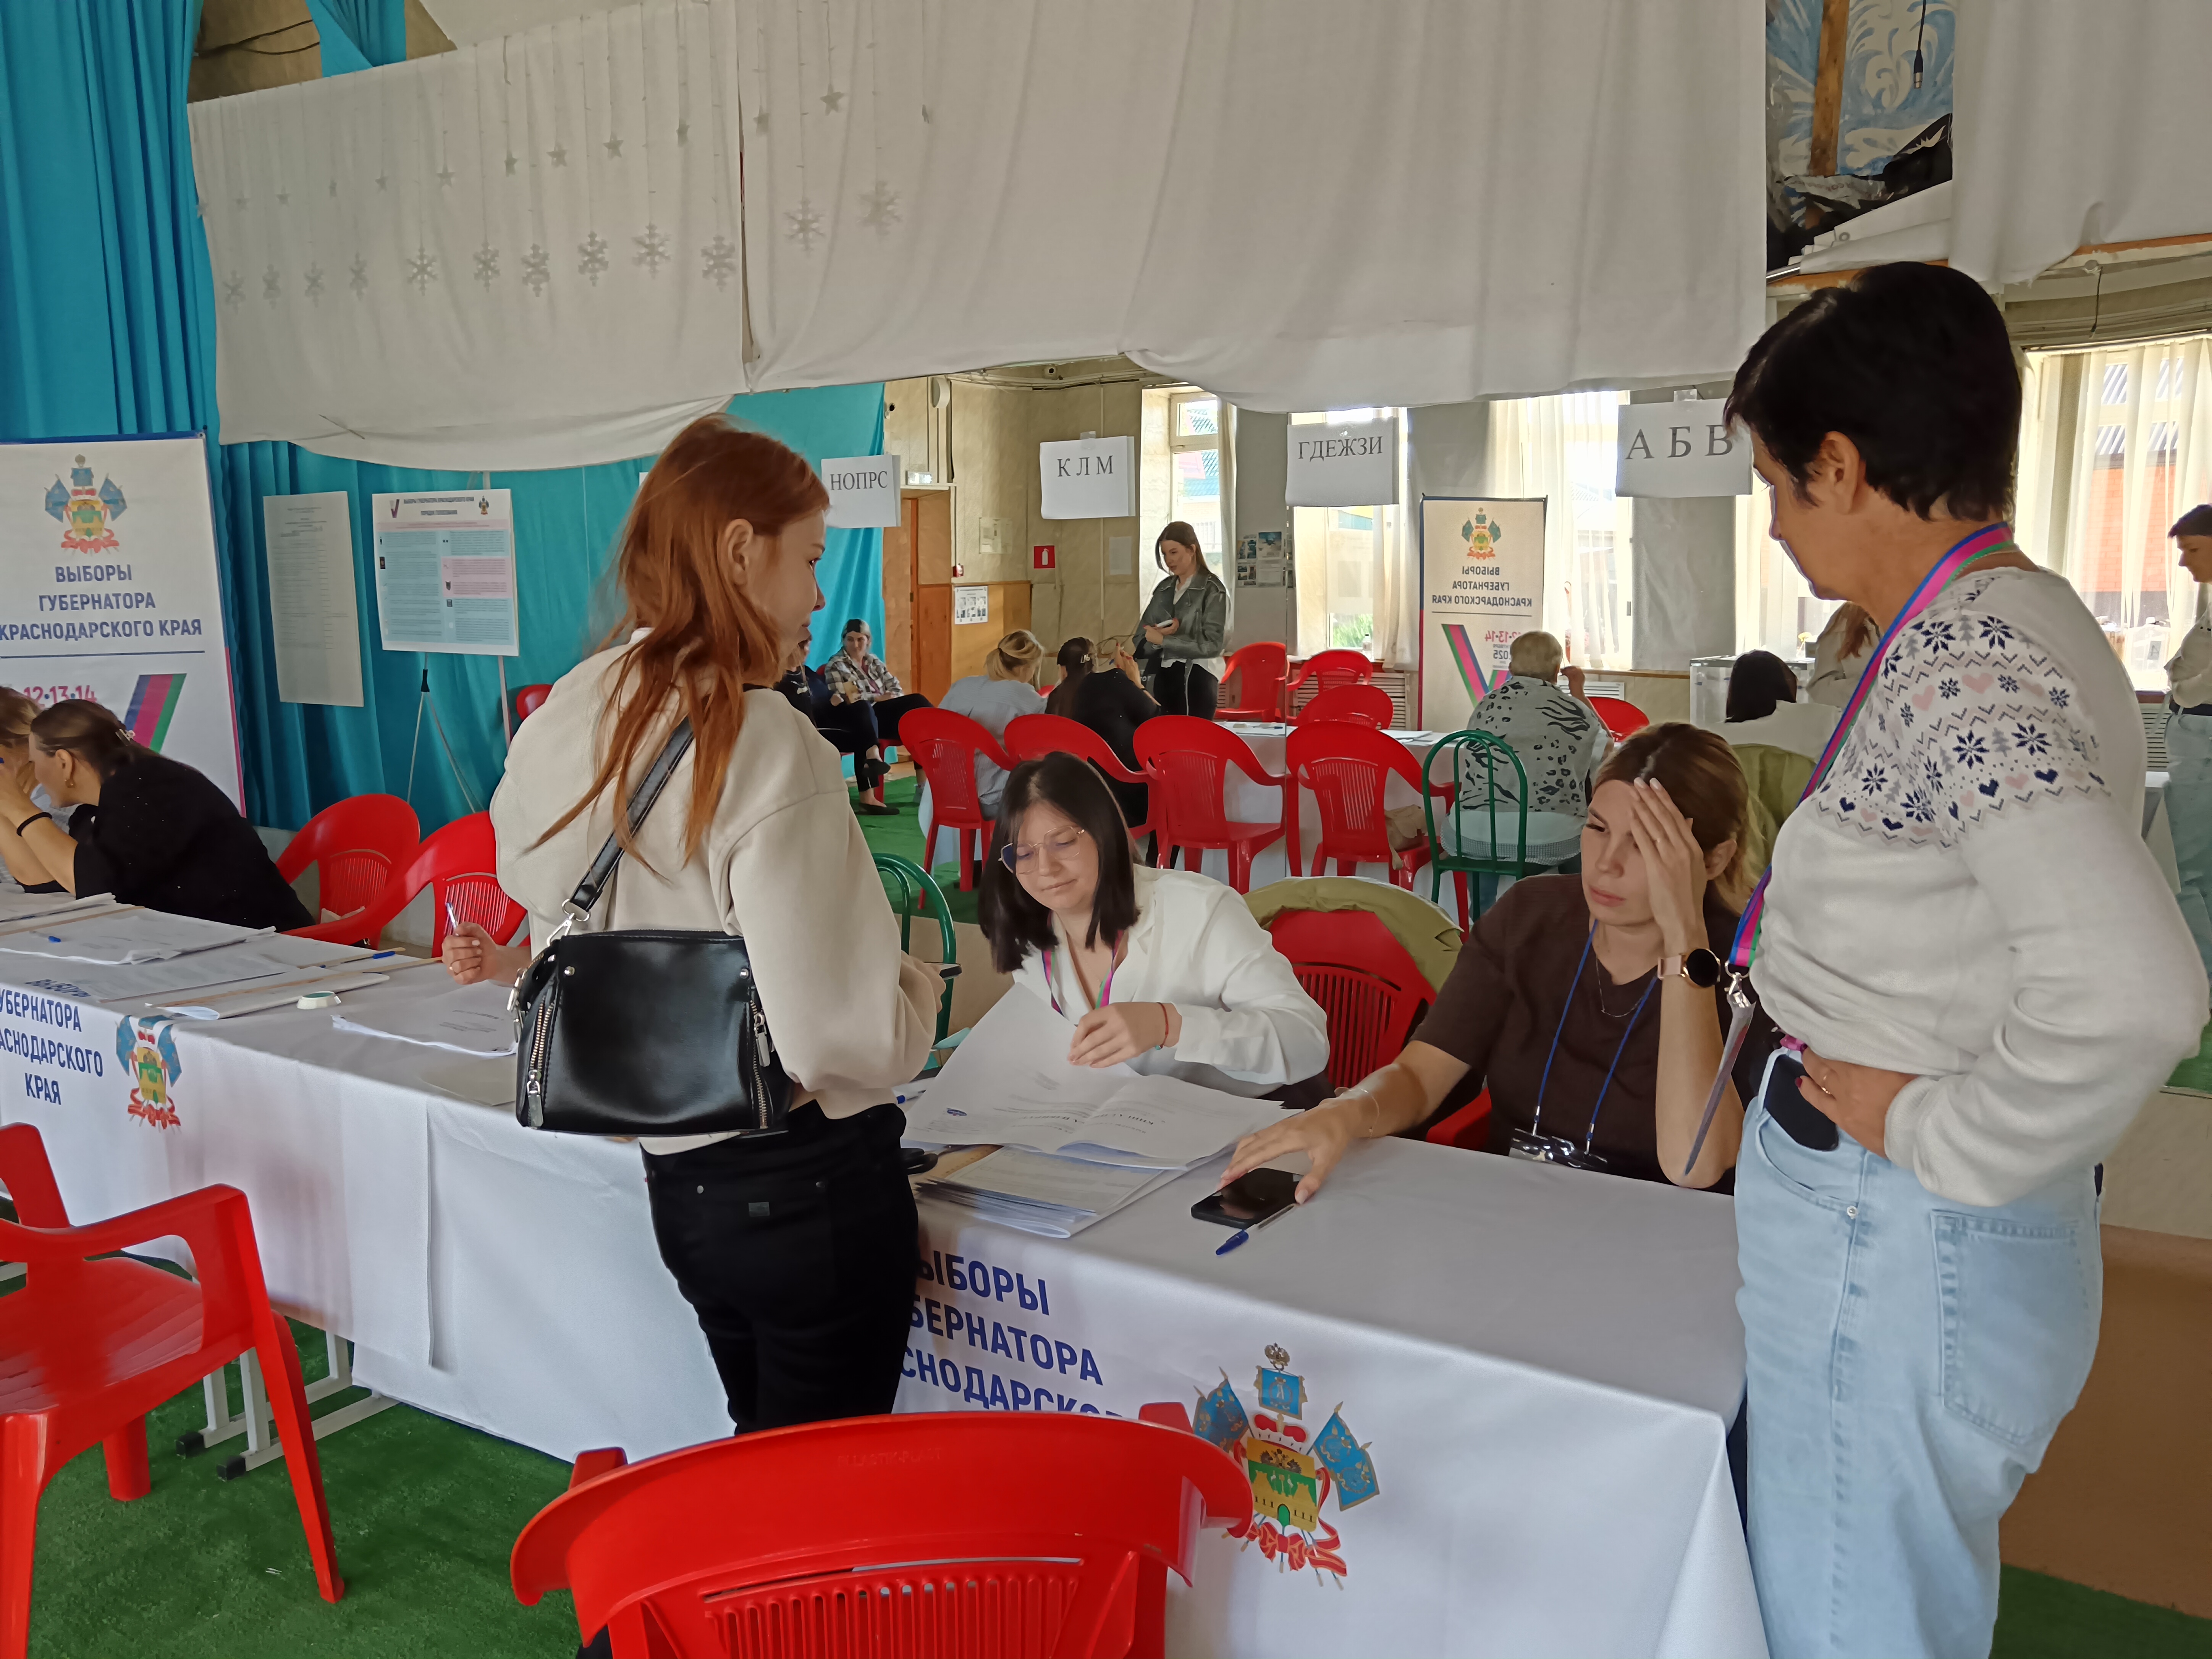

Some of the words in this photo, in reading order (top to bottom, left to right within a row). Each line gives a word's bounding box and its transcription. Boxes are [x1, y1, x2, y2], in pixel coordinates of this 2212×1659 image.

[1298, 436, 1383, 462] ГДЕЖЗИ
[1624, 428, 1654, 459] А
[1667, 426, 1691, 458] Б
[1704, 424, 1733, 456] В
[830, 471, 888, 490] НОПРС
[1057, 458, 1071, 477] К
[1076, 457, 1090, 476] Л
[1096, 455, 1113, 474] М
[55, 564, 132, 582] ВЫБОРЫ
[39, 592, 156, 611] ГУБЕРНАТОРА
[0, 619, 154, 641] КРАСНОДАРСКОГО
[158, 619, 202, 636] КРАЯ
[0, 988, 82, 1032] УБЕРНАТОРА
[0, 1028, 103, 1077] АСНОДАРСКОГО
[25, 1072, 61, 1105] КРАЯ
[917, 1250, 1049, 1316] ЫБОРЫ
[910, 1294, 1103, 1386] БЕРНАТОРА
